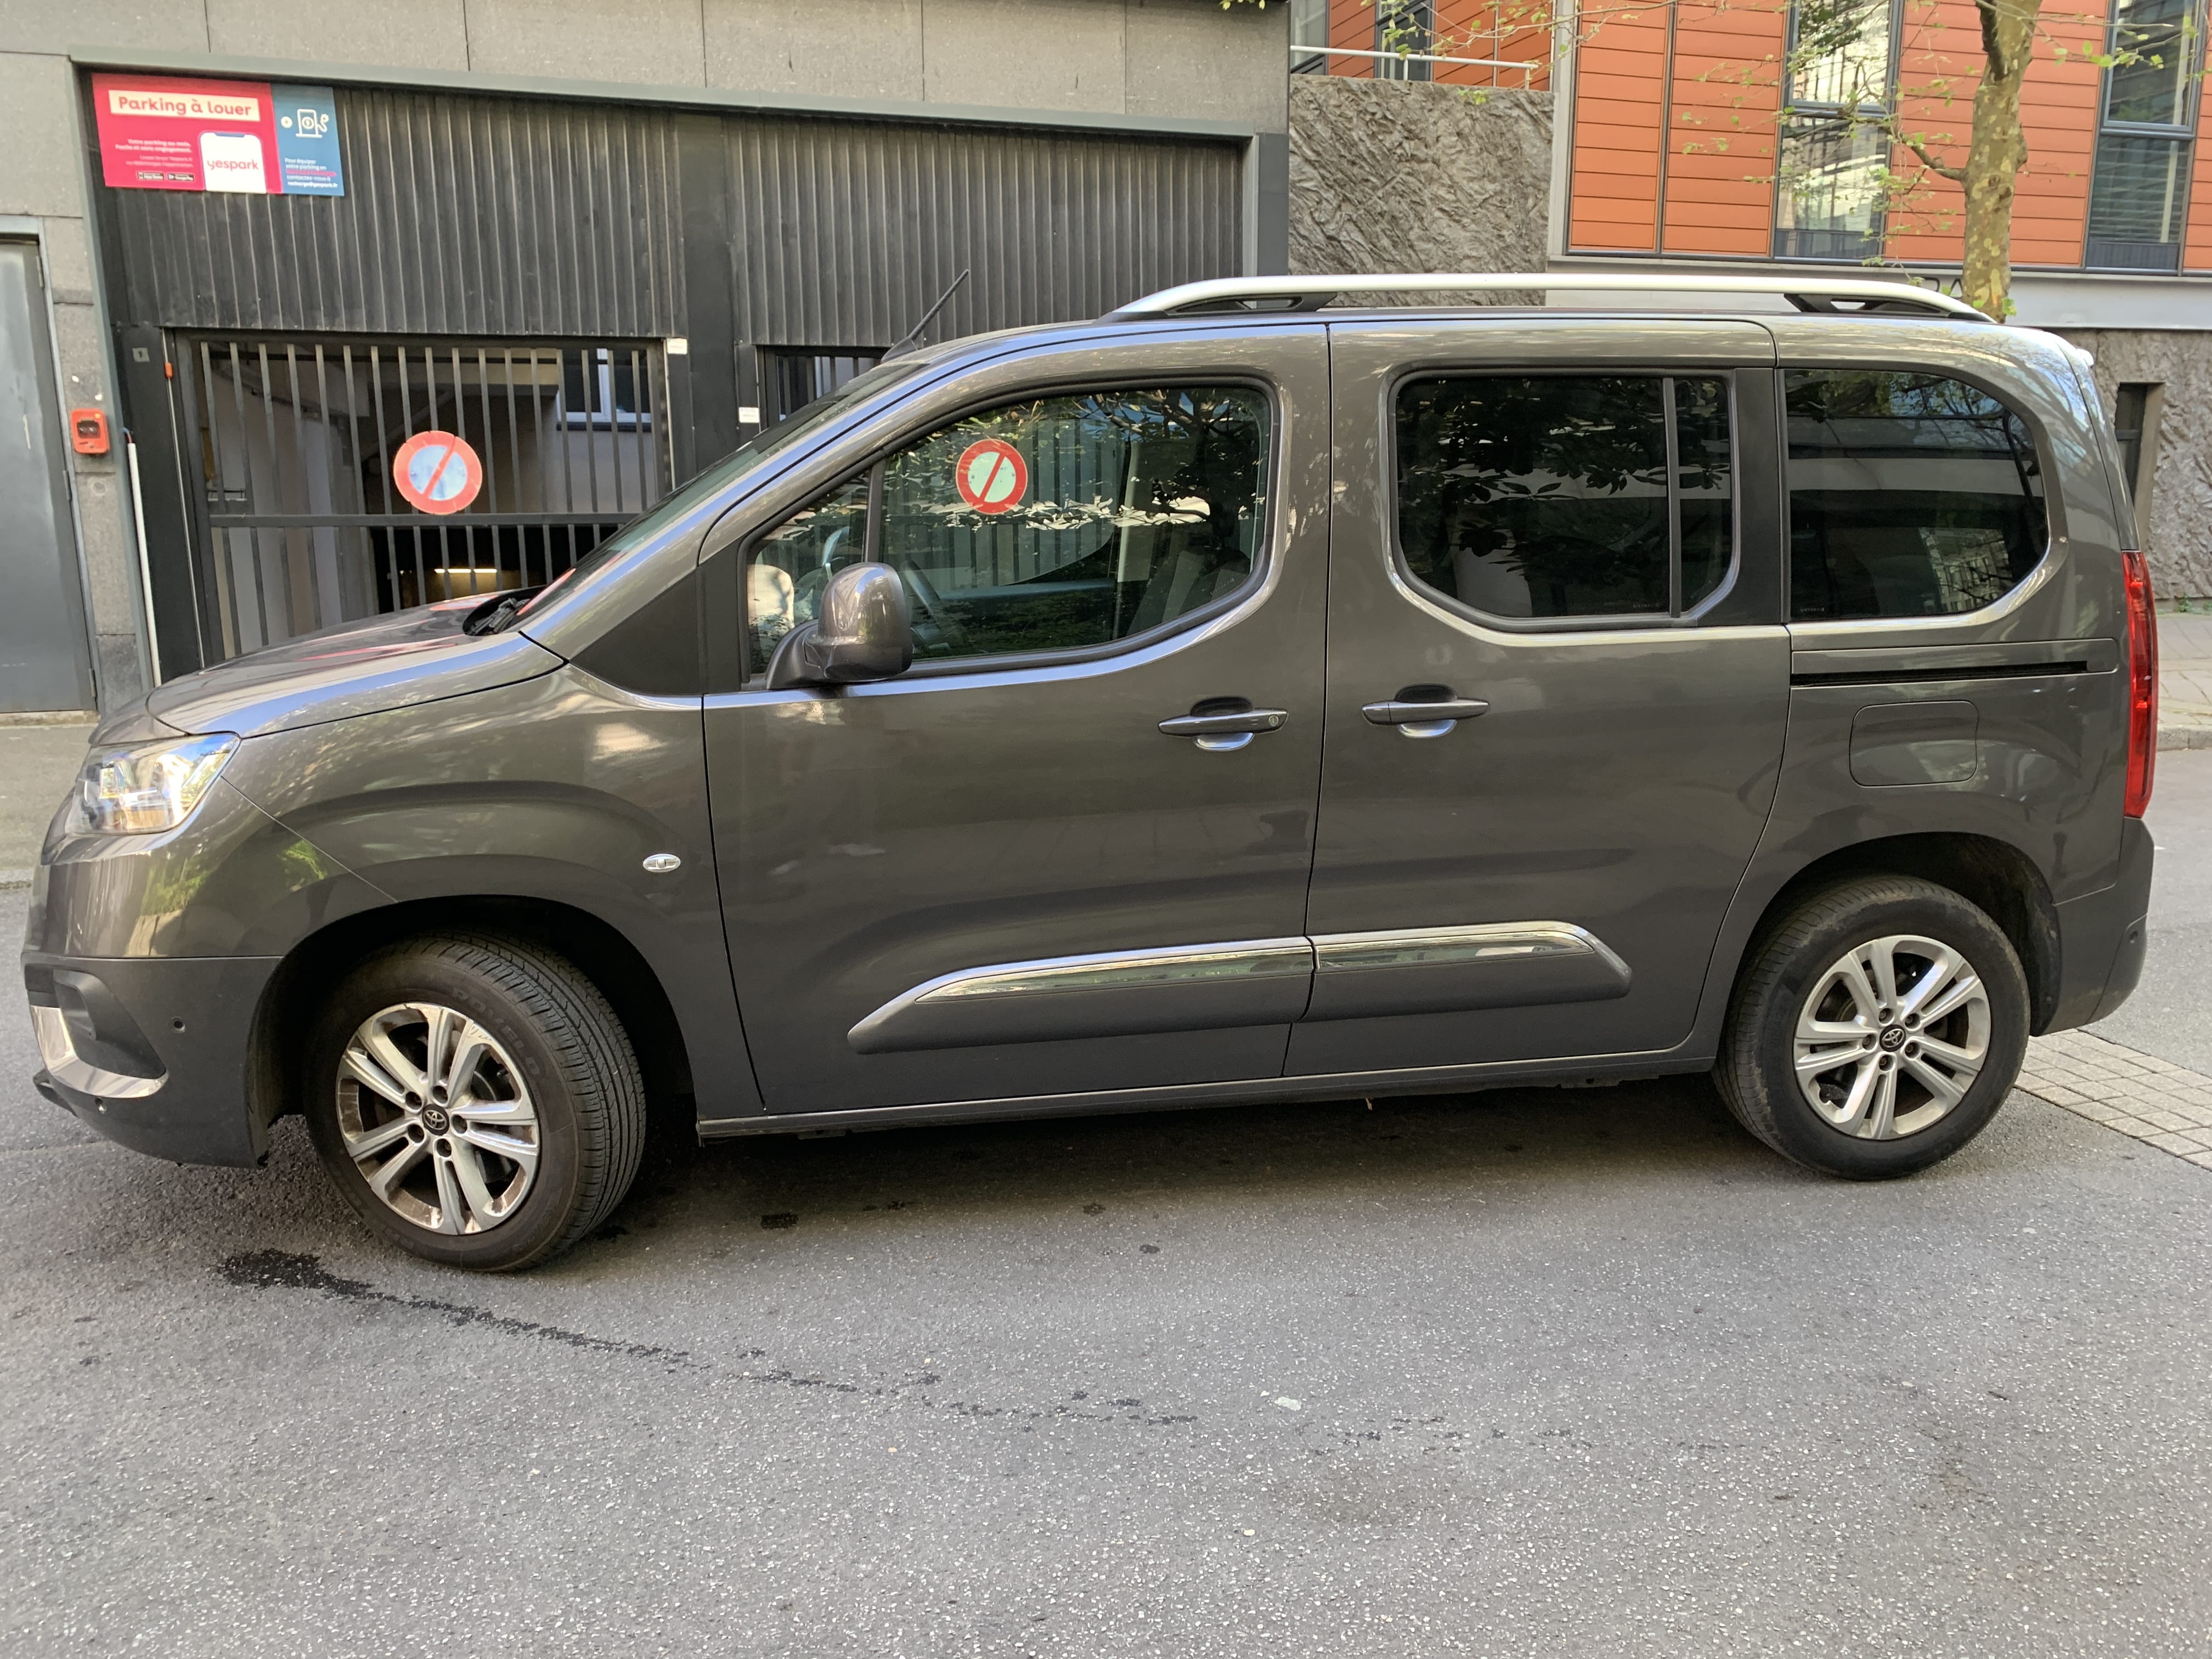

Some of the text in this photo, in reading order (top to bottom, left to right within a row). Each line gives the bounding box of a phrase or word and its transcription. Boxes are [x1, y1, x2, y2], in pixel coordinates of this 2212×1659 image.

[119, 95, 252, 116] Parking à louer
[207, 158, 259, 172] yespark
